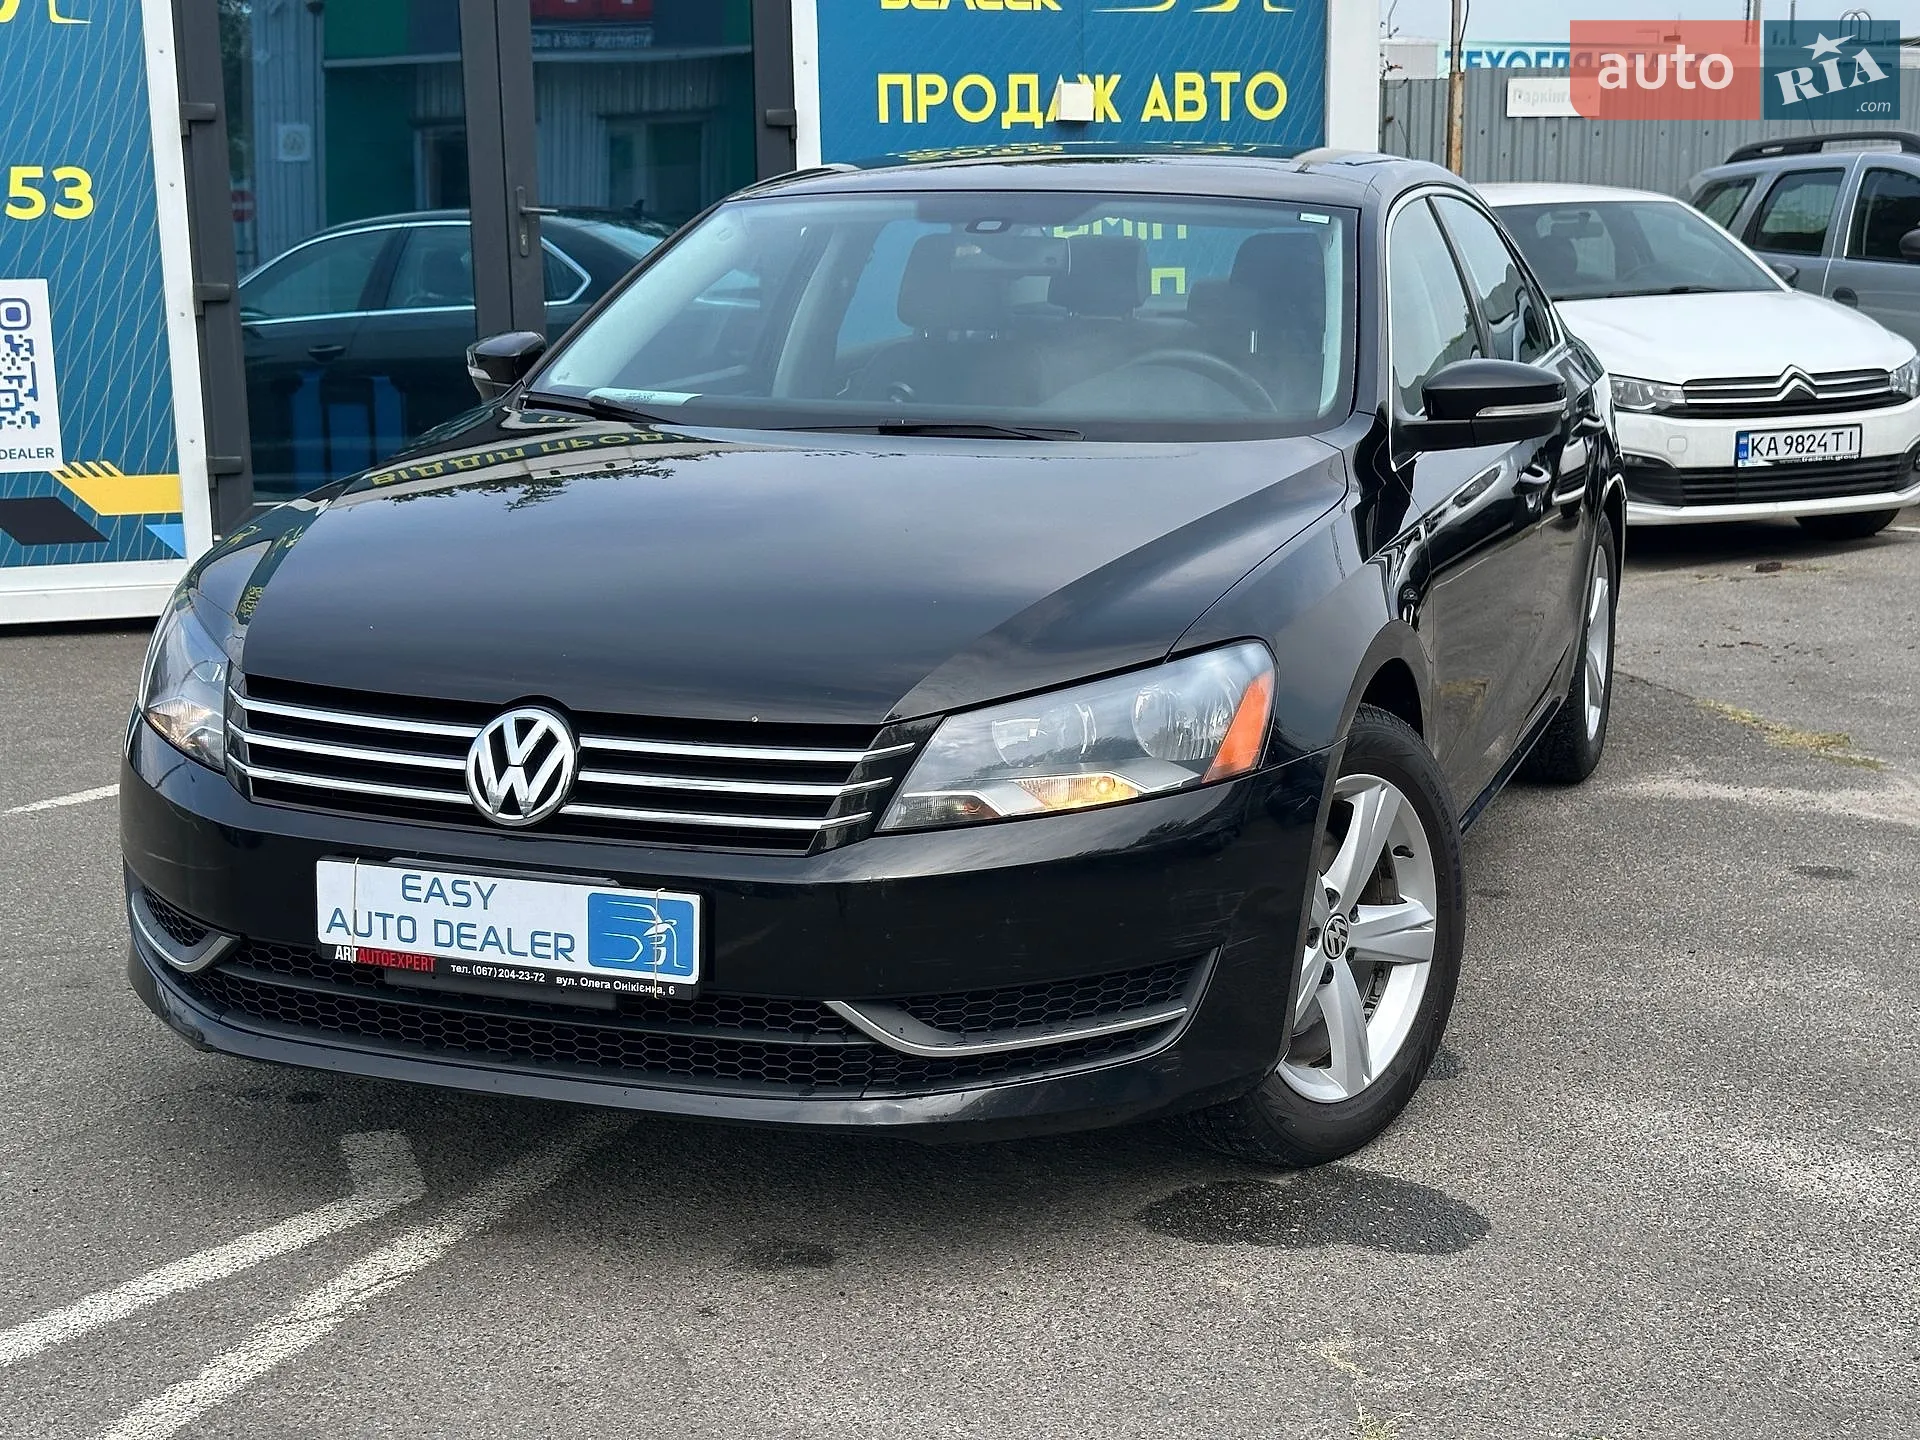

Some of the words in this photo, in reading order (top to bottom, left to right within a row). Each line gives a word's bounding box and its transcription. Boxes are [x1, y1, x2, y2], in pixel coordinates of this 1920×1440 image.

[1141, 71, 1288, 122] АВТО
[5, 166, 94, 220] 53
[0, 447, 55, 460] DEALER
[1751, 436, 1778, 457] KA
[1783, 433, 1827, 455] 9824
[402, 873, 498, 911] EASY
[326, 907, 418, 944] AUTO
[433, 918, 576, 963] DEALER
[451, 964, 471, 975] тел.
[555, 975, 578, 987] вул.
[580, 977, 611, 990] Олега
[668, 984, 675, 995] 6
